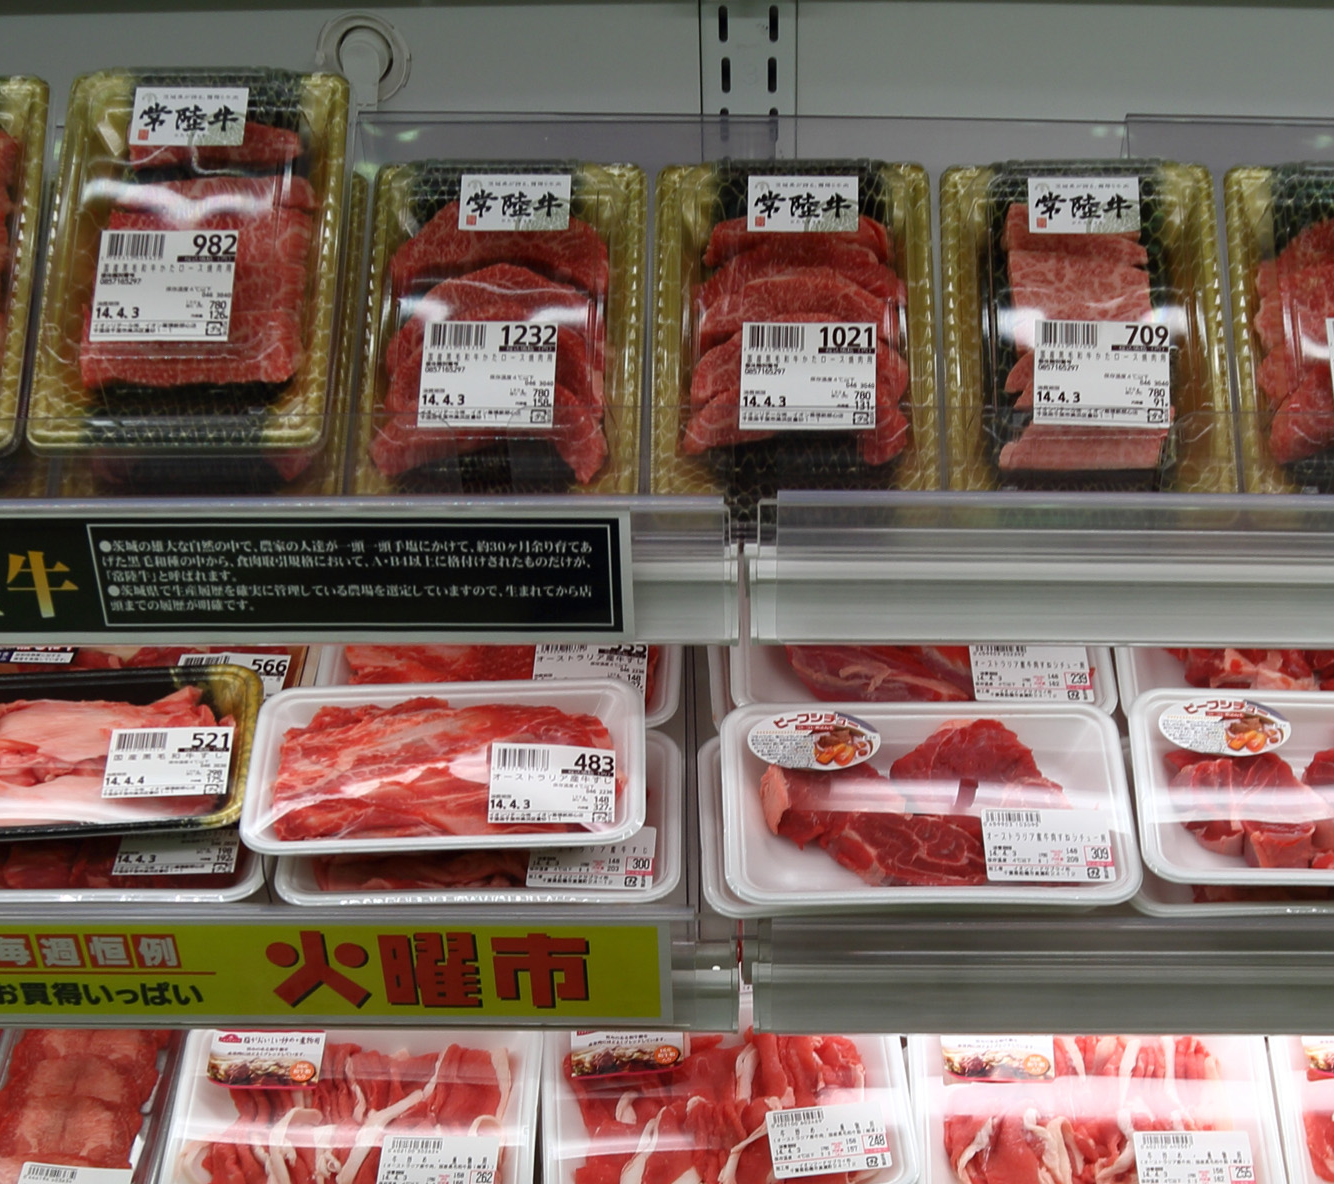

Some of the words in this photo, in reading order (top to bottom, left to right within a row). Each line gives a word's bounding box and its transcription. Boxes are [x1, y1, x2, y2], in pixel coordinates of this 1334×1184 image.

[140, 102, 238, 132] 常陸牛
[467, 193, 562, 219] 常陸牛
[754, 194, 851, 220] 常陸牛
[1034, 193, 1133, 219] 常陸牛
[193, 234, 237, 255] 982
[500, 325, 557, 347] 1232
[819, 326, 874, 347] 1021
[1125, 325, 1169, 347] 709
[251, 658, 287, 673] 566
[1183, 700, 1269, 716] ビーフシチュー
[773, 713, 860, 729] ビーフシチュー
[191, 732, 230, 748] 521
[574, 753, 615, 772] 483
[1090, 848, 1109, 860] 309
[631, 858, 651, 870] 300
[265, 930, 590, 1009] 火曜市
[867, 1136, 886, 1147] 248
[475, 1171, 493, 1184] 262
[1234, 1166, 1254, 1180] 255
